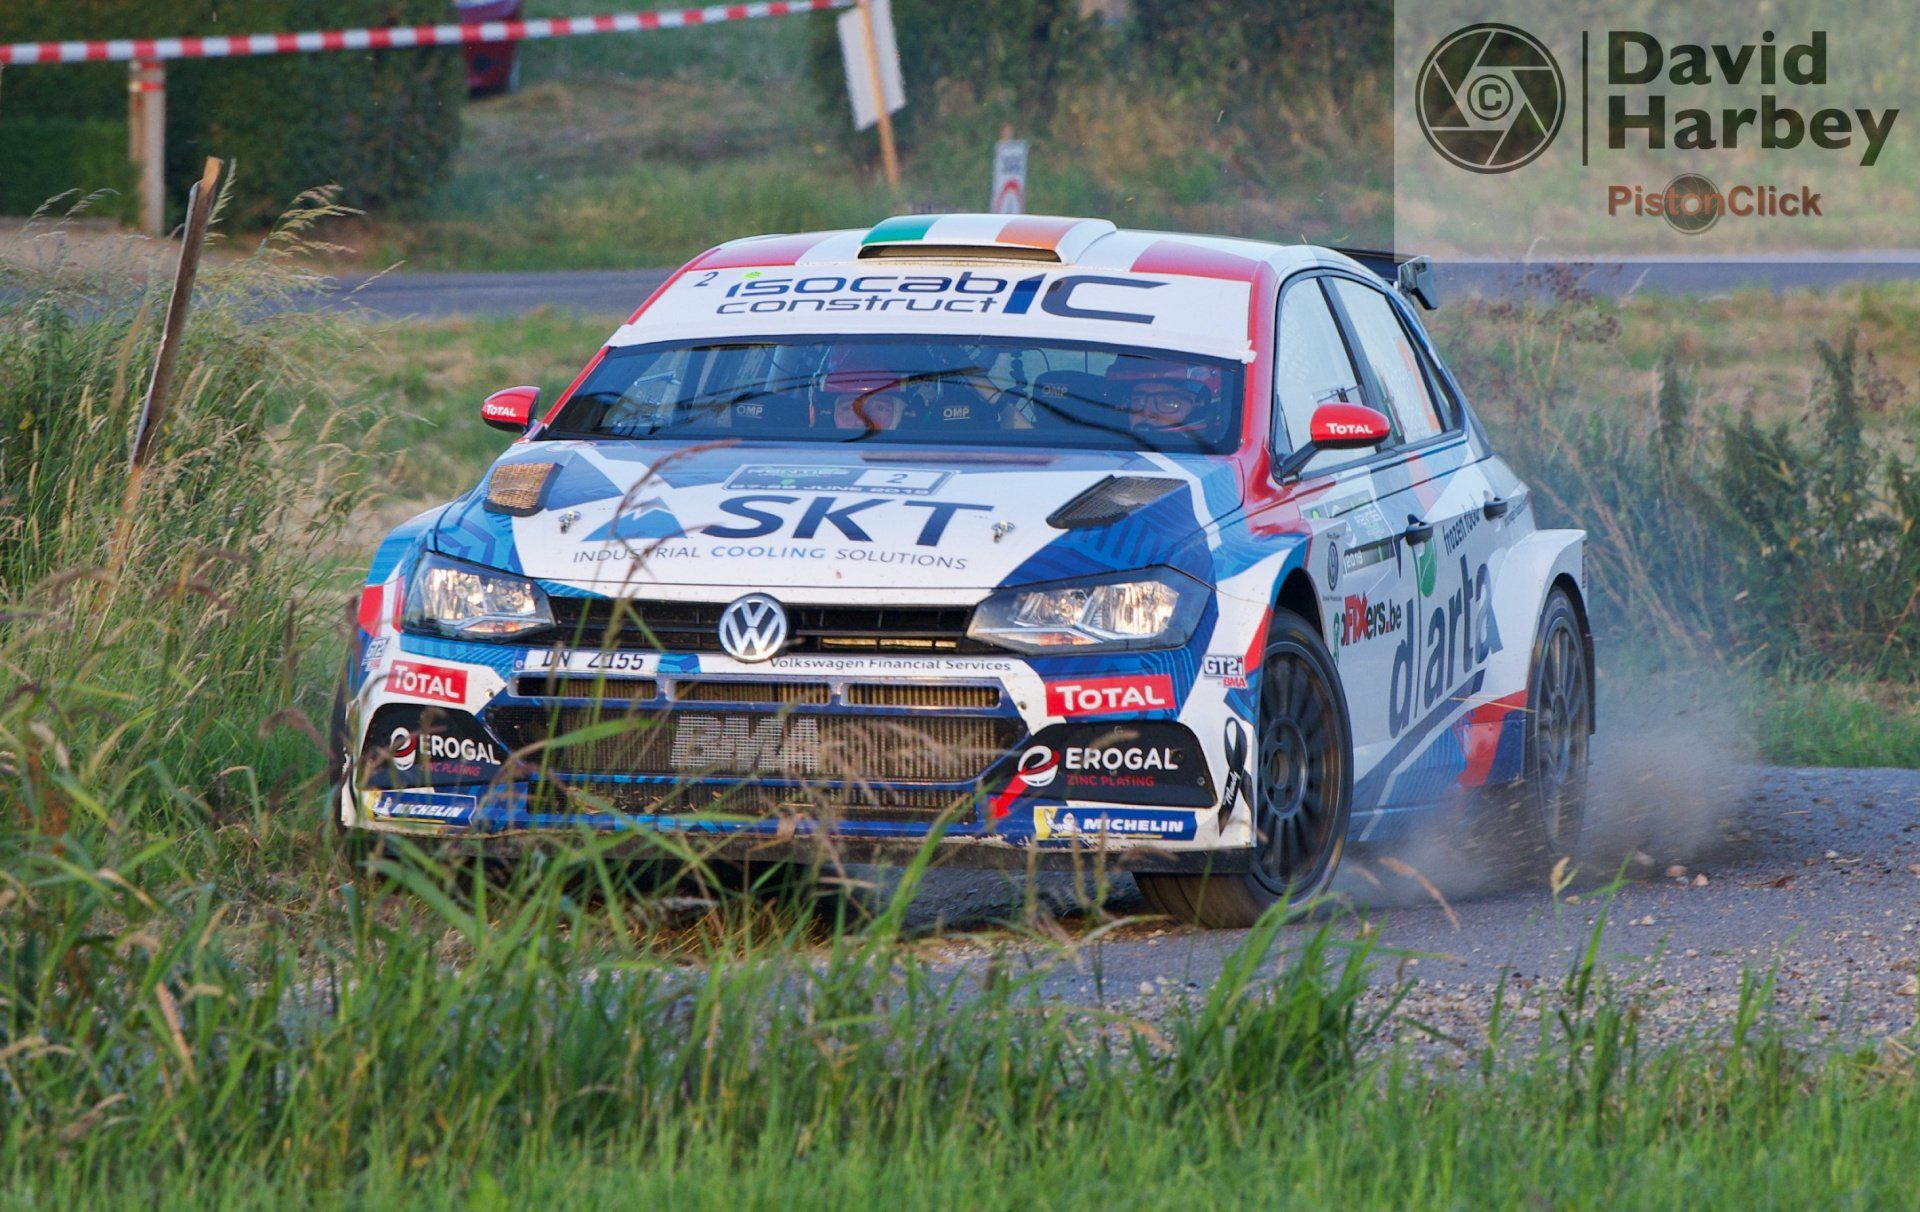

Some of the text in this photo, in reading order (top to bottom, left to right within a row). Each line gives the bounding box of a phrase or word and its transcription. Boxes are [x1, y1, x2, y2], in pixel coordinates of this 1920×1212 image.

[693, 271, 719, 288] 2
[725, 269, 1005, 298] isocab
[716, 295, 997, 315] construct
[486, 404, 517, 418] TOTAL
[736, 404, 764, 418] OMP
[943, 405, 970, 419] OMP
[1325, 422, 1374, 435] TOTAL
[890, 472, 909, 484] 2
[700, 495, 995, 548] SKT
[572, 545, 968, 571] INDUSTRIAL COOLING SOLUTIONS
[1345, 550, 1364, 569] 2019
[769, 657, 1012, 674] Volkswagen Financial Services
[1203, 656, 1245, 676] GT2i
[394, 664, 460, 699] TOTAL
[1222, 676, 1247, 689] BMA
[1055, 684, 1166, 712] TOTAL
[419, 733, 502, 766] EROGAL
[1065, 746, 1179, 771] EROGAL
[1066, 774, 1155, 788] ZINC PLATING
[390, 802, 465, 818] MCHELIN
[1082, 817, 1184, 833] MICHELIN
